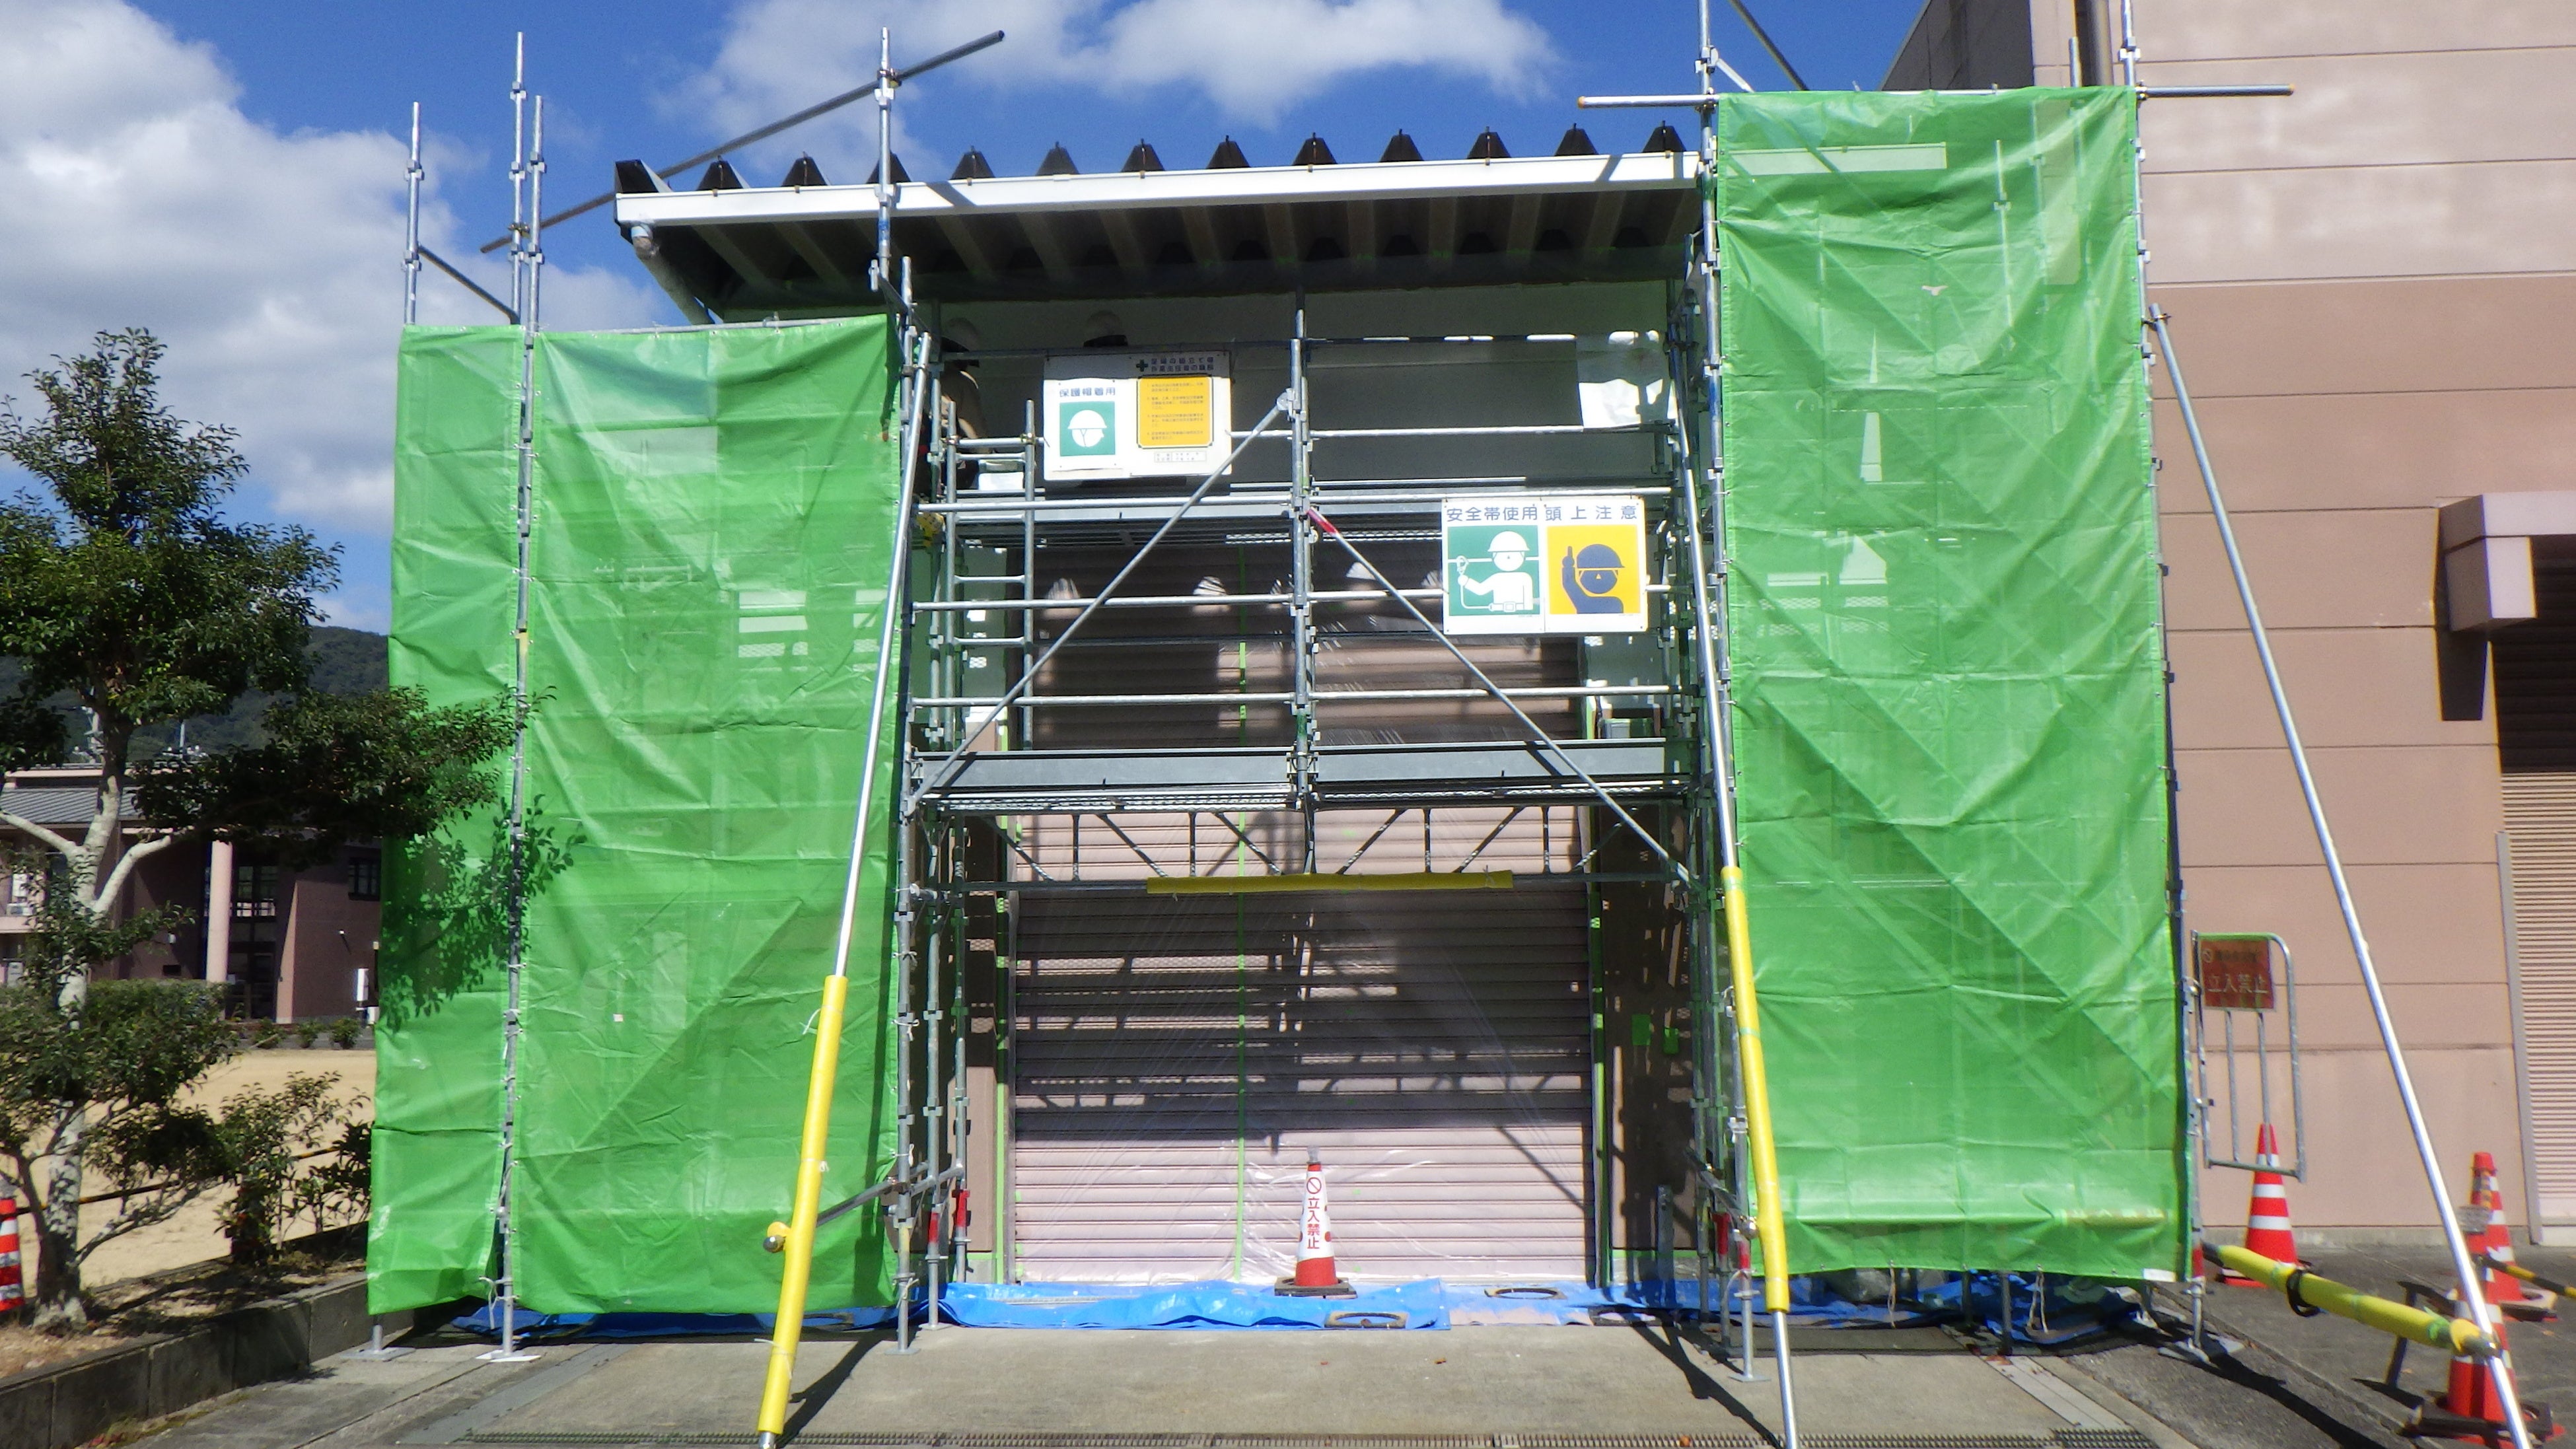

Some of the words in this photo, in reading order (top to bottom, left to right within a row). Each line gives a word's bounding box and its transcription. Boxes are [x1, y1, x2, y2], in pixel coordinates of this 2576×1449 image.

[1059, 387, 1116, 398] 保護帽着用
[1447, 506, 1538, 522] 安全帯使用
[1545, 505, 1637, 520] 頭上注意
[1307, 1197, 1320, 1250] 立入禁止
